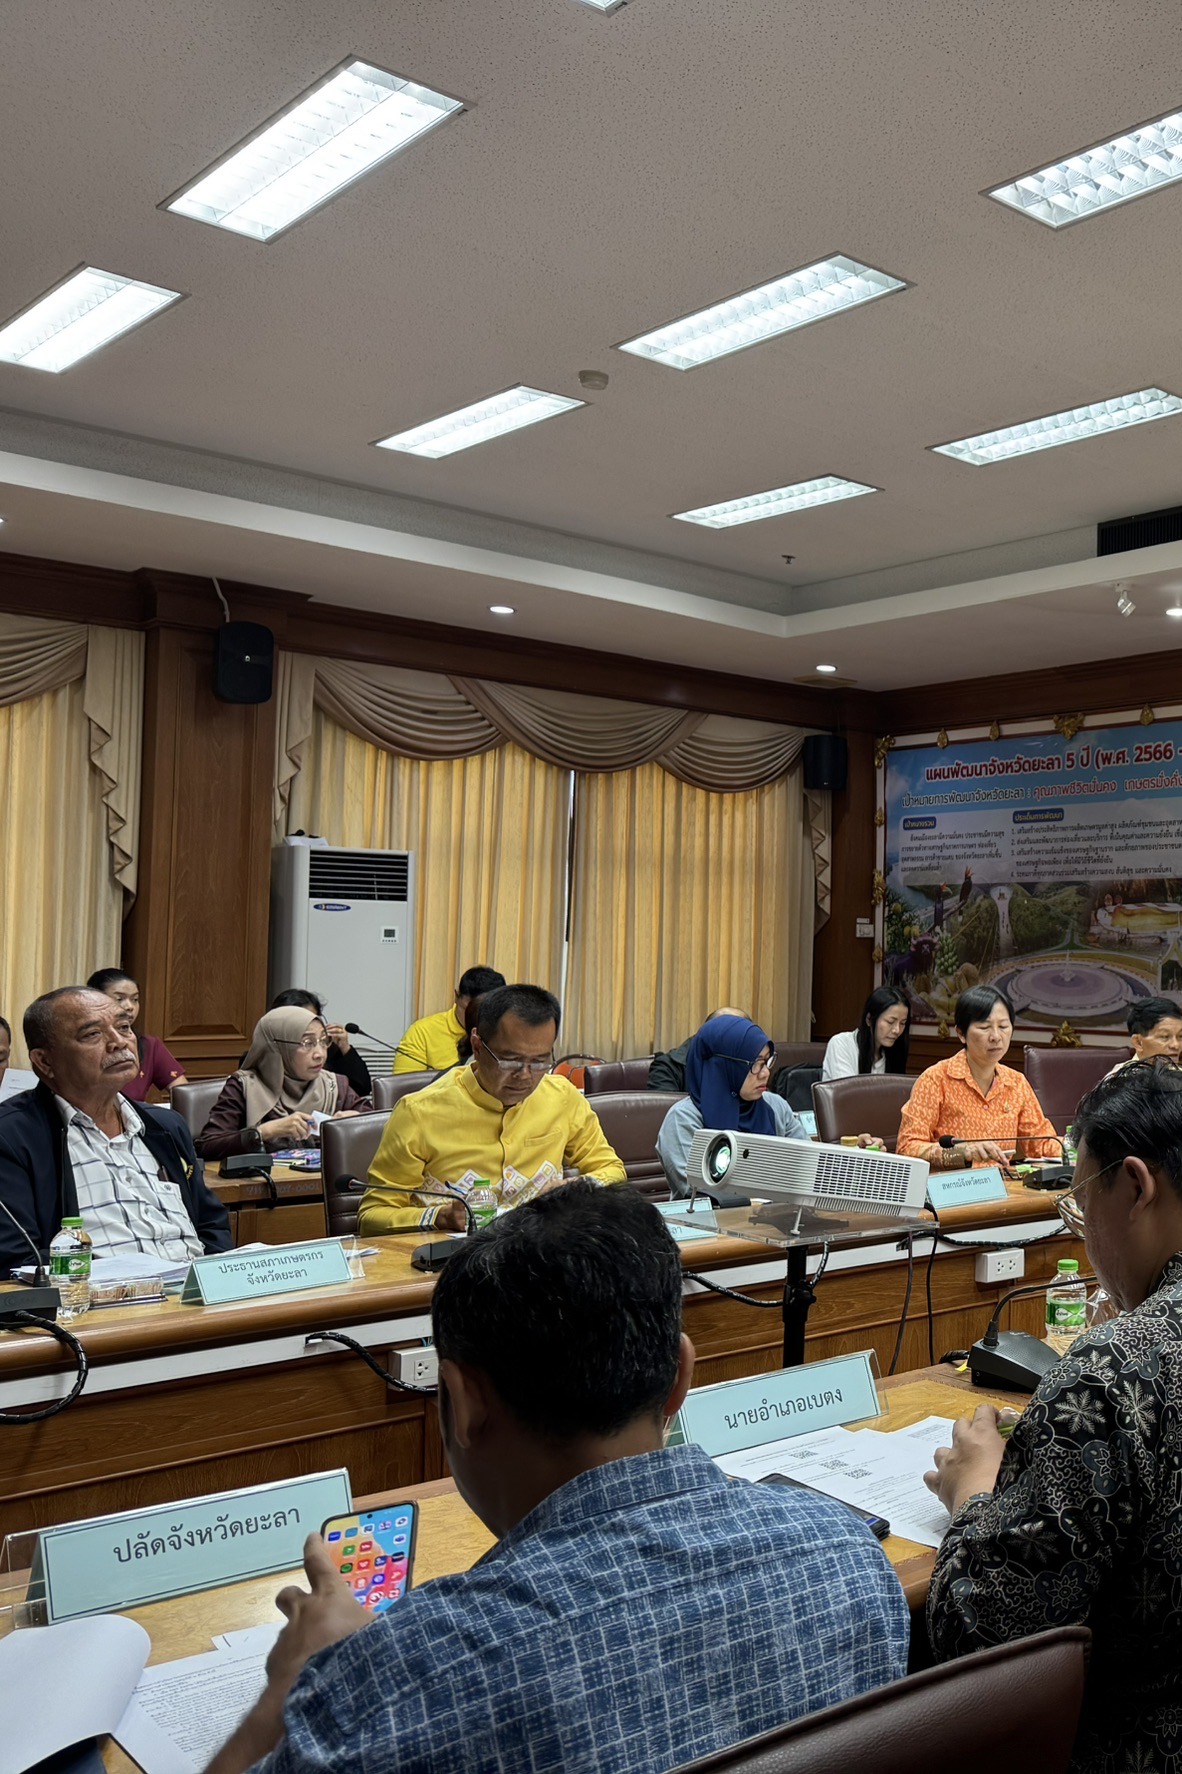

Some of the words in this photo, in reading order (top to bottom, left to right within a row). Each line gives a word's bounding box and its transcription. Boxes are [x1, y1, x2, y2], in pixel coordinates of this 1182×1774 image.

[925, 753, 1062, 781] แผนพัฒนาจังหวัดยะลา
[1066, 754, 1075, 769] 5
[1080, 746, 1091, 768] ปี
[1095, 749, 1129, 770] (พ.ศ.
[1134, 743, 1174, 763] 2566
[902, 786, 1024, 808] เป้าหมายการพัฒนาจังหวัดยะลา
[1034, 776, 1117, 798] คุณภาพชีวิตมั่นคง
[218, 1250, 324, 1275] ประธานสภาเกษตรกร
[246, 1268, 308, 1286] จังหวัดยะลา
[724, 1386, 843, 1430] นายอำเภอเบตง
[113, 1506, 301, 1564] ปลัดจังหวัดยะลา
